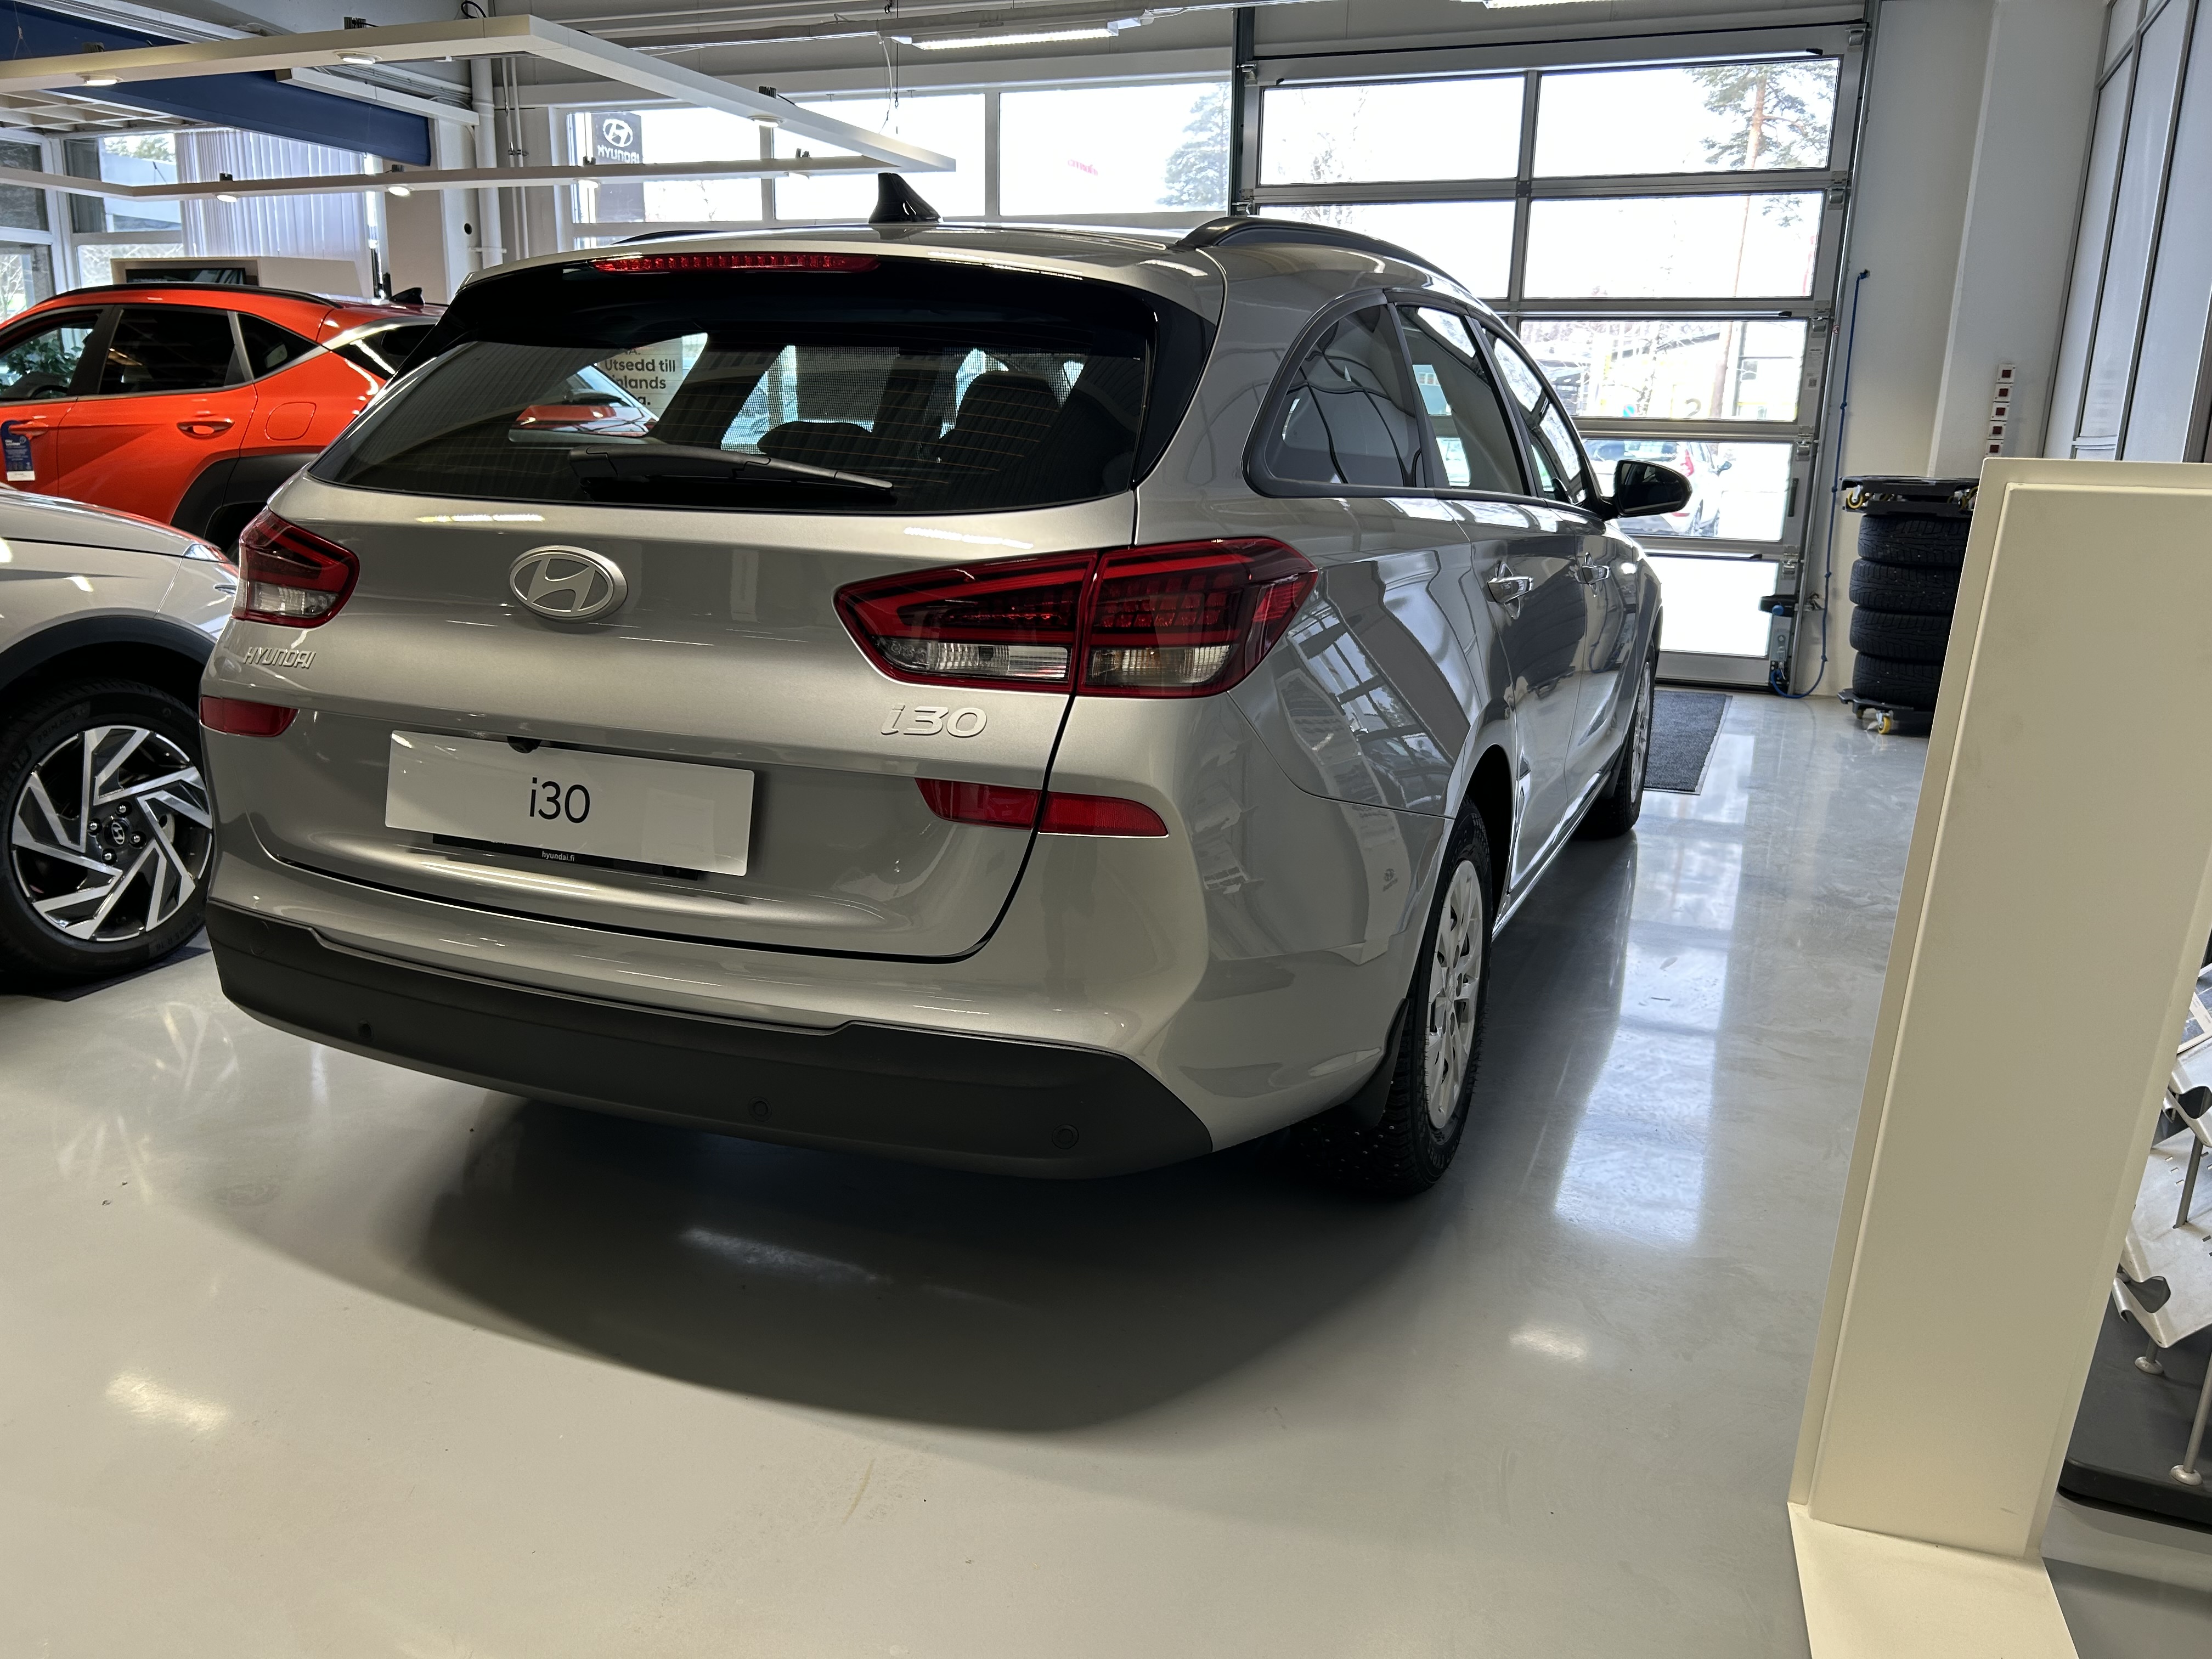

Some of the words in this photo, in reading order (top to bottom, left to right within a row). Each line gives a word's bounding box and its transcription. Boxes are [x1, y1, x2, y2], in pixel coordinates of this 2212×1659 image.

[597, 144, 640, 164] HYUNDAI
[605, 359, 655, 372] Utsedd
[659, 359, 675, 373] till
[242, 647, 317, 669] HYUNDAI
[881, 703, 988, 738] i30
[529, 777, 590, 823] i30
[541, 851, 575, 862] hyundai.fi
